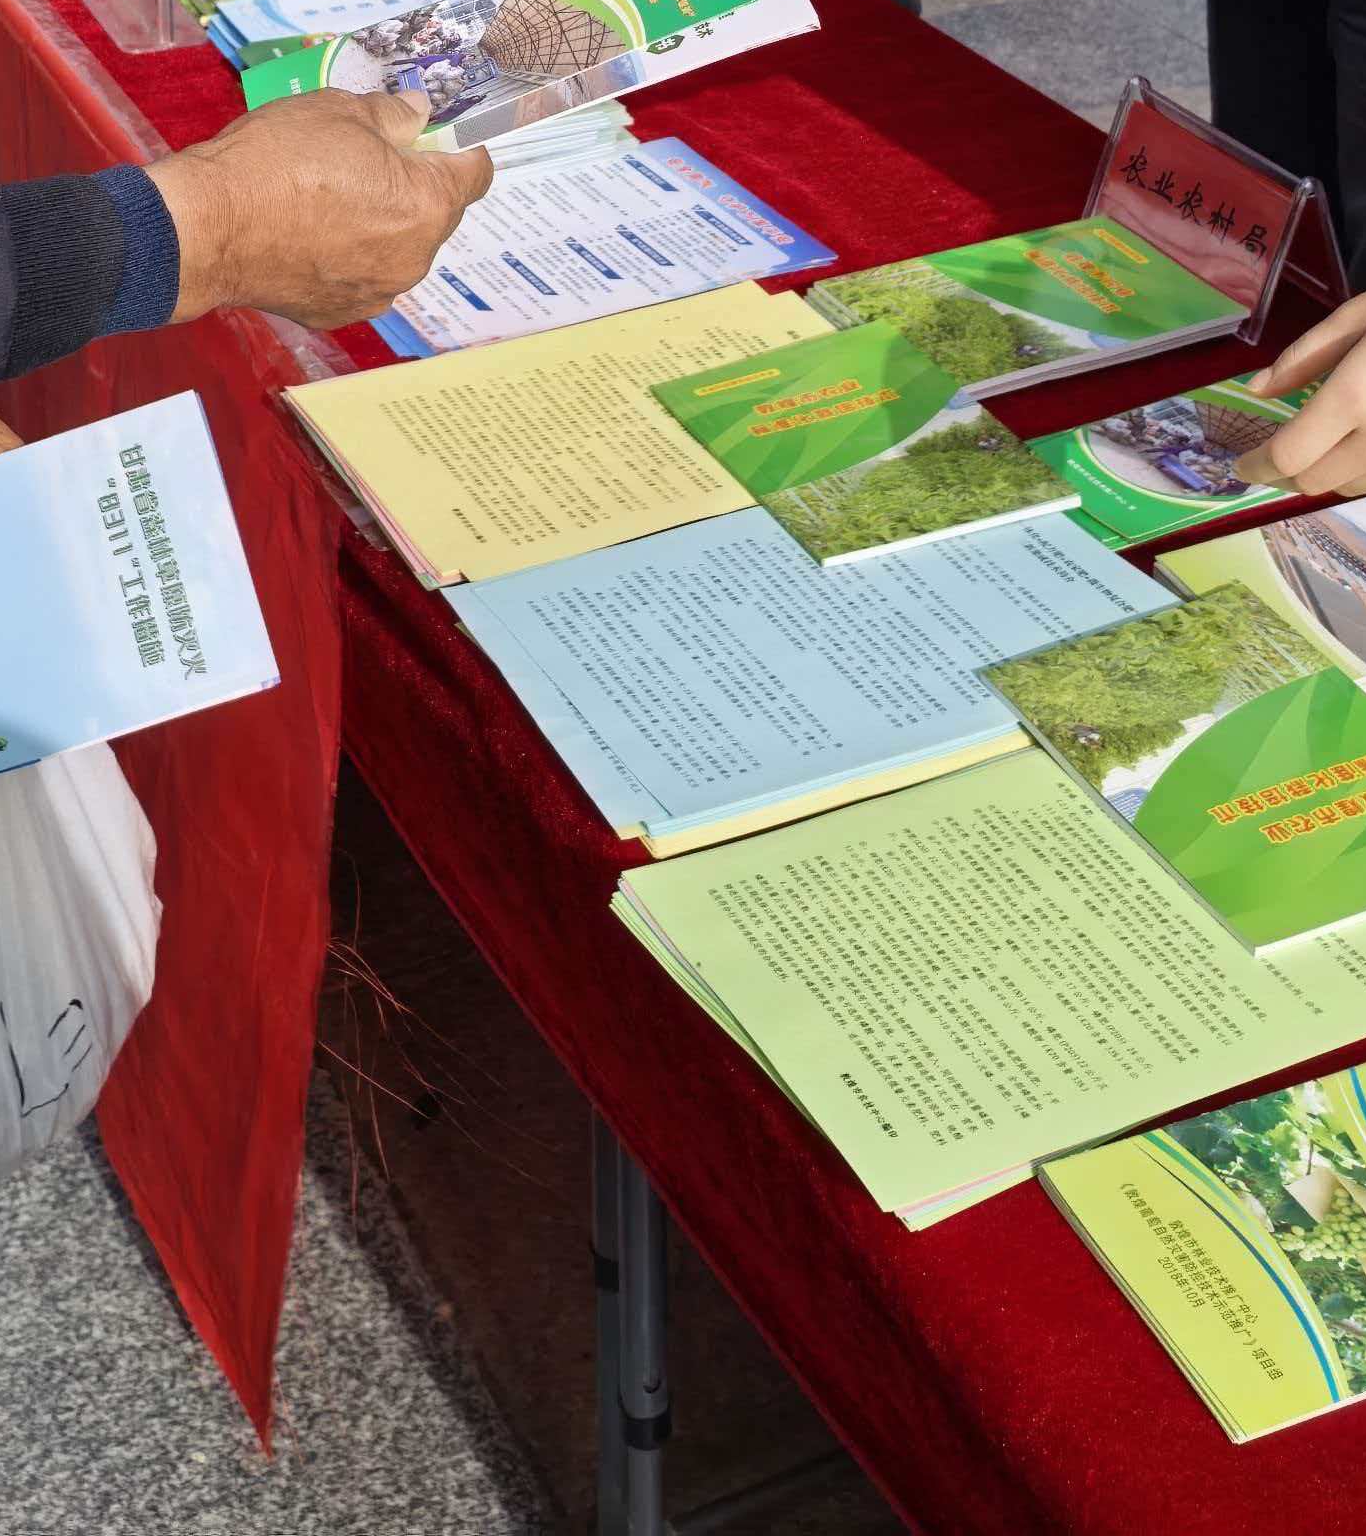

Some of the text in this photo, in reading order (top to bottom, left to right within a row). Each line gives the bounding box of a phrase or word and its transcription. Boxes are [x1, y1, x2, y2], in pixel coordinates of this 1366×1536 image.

[1120, 146, 1268, 261] 农业农村局
[1168, 1219, 1259, 1324] 敦煌市林业技术推广中心
